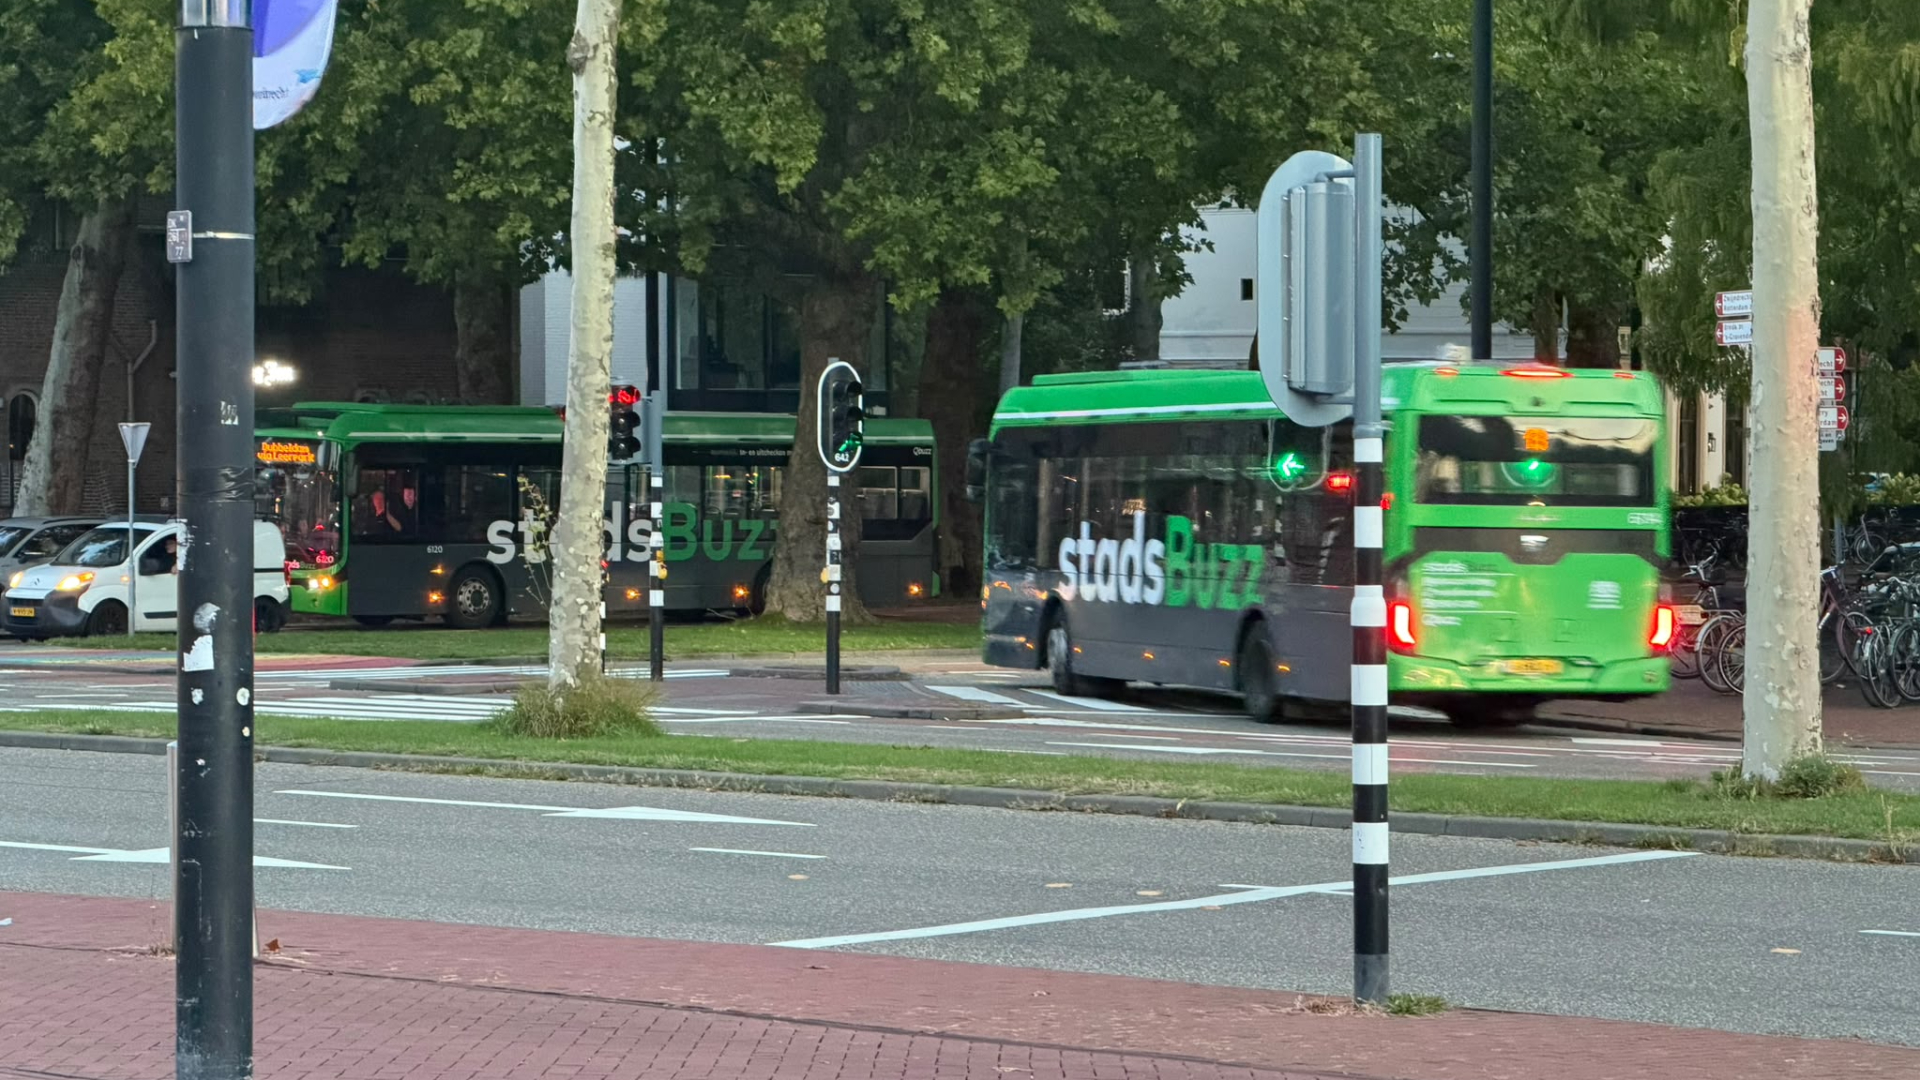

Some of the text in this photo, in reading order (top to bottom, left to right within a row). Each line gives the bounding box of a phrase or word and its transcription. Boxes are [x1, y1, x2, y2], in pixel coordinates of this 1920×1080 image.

[262, 442, 310, 453] Dubbeldam
[912, 446, 932, 456] Qbuzz
[257, 452, 316, 463] via Leerpark
[834, 452, 850, 462] 642
[486, 500, 780, 564] stdsBuz
[427, 545, 443, 554] 6120
[1059, 510, 1264, 610] stadsBuzz
